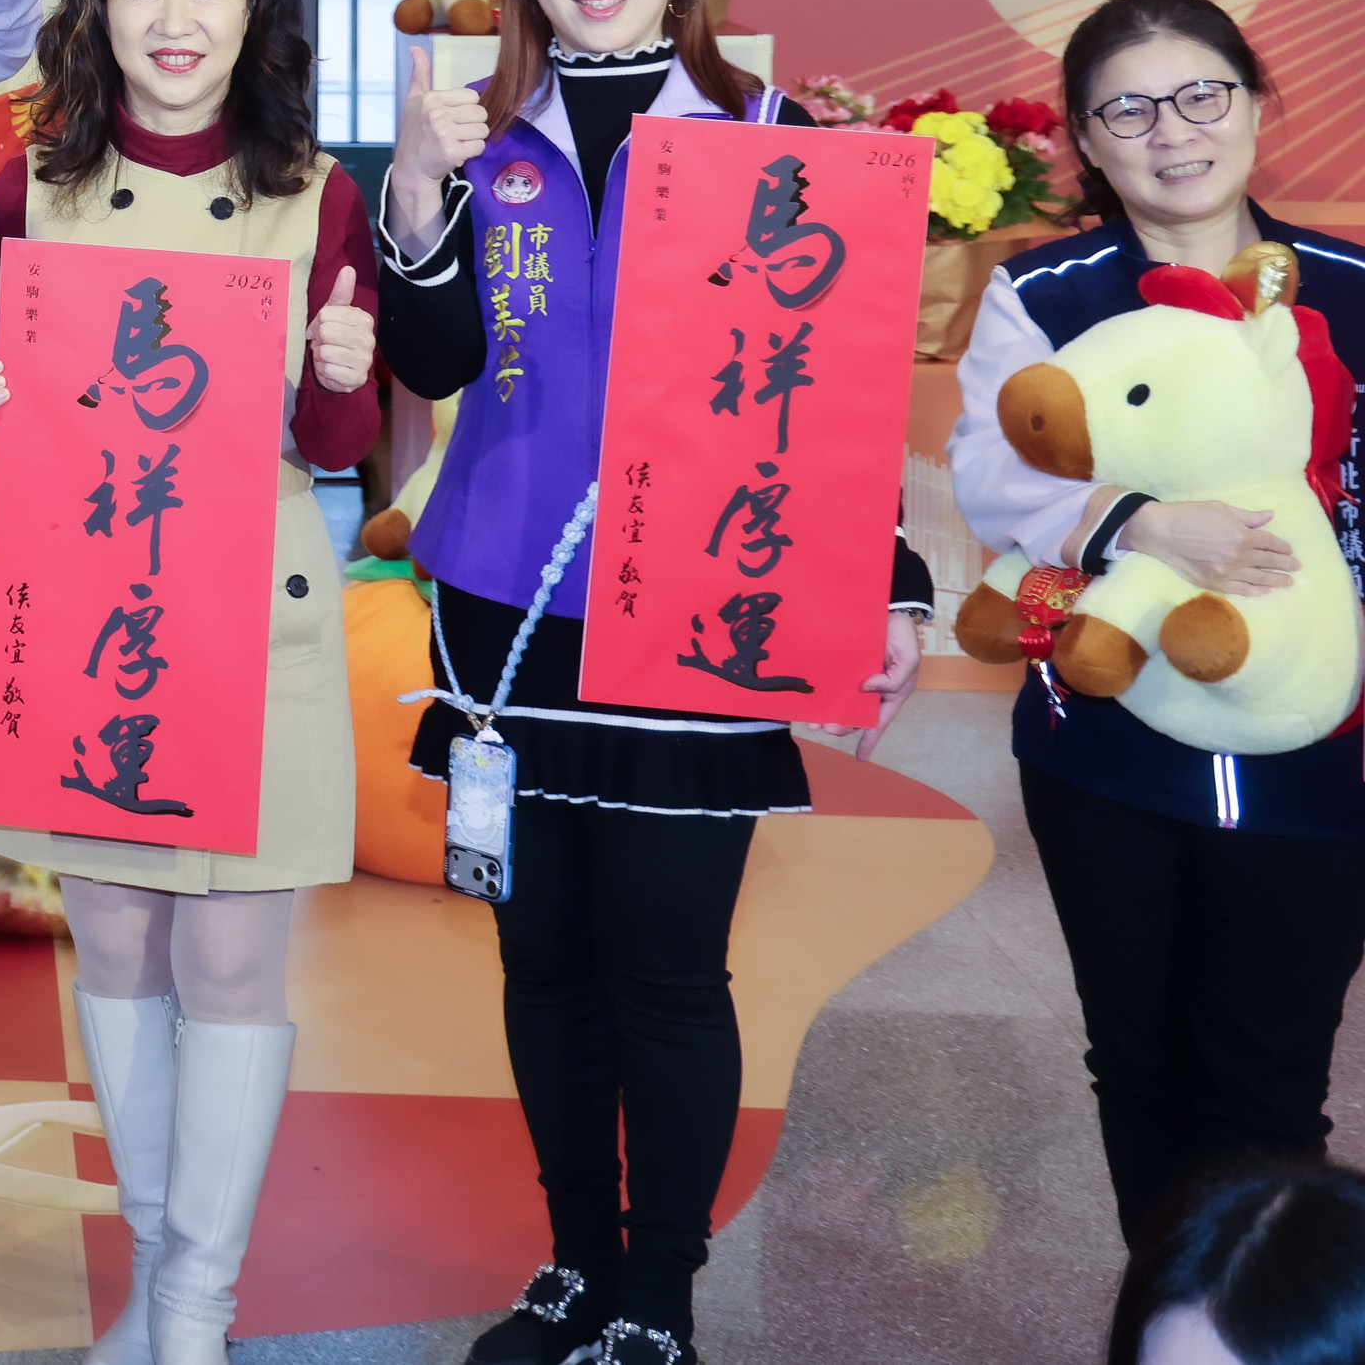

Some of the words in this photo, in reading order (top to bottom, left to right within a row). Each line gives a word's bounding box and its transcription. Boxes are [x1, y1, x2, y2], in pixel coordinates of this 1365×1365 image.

[866, 150, 917, 169] 2026
[225, 273, 274, 291] 2026
[522, 222, 555, 317] 市議員
[482, 221, 526, 404] 劉美芳
